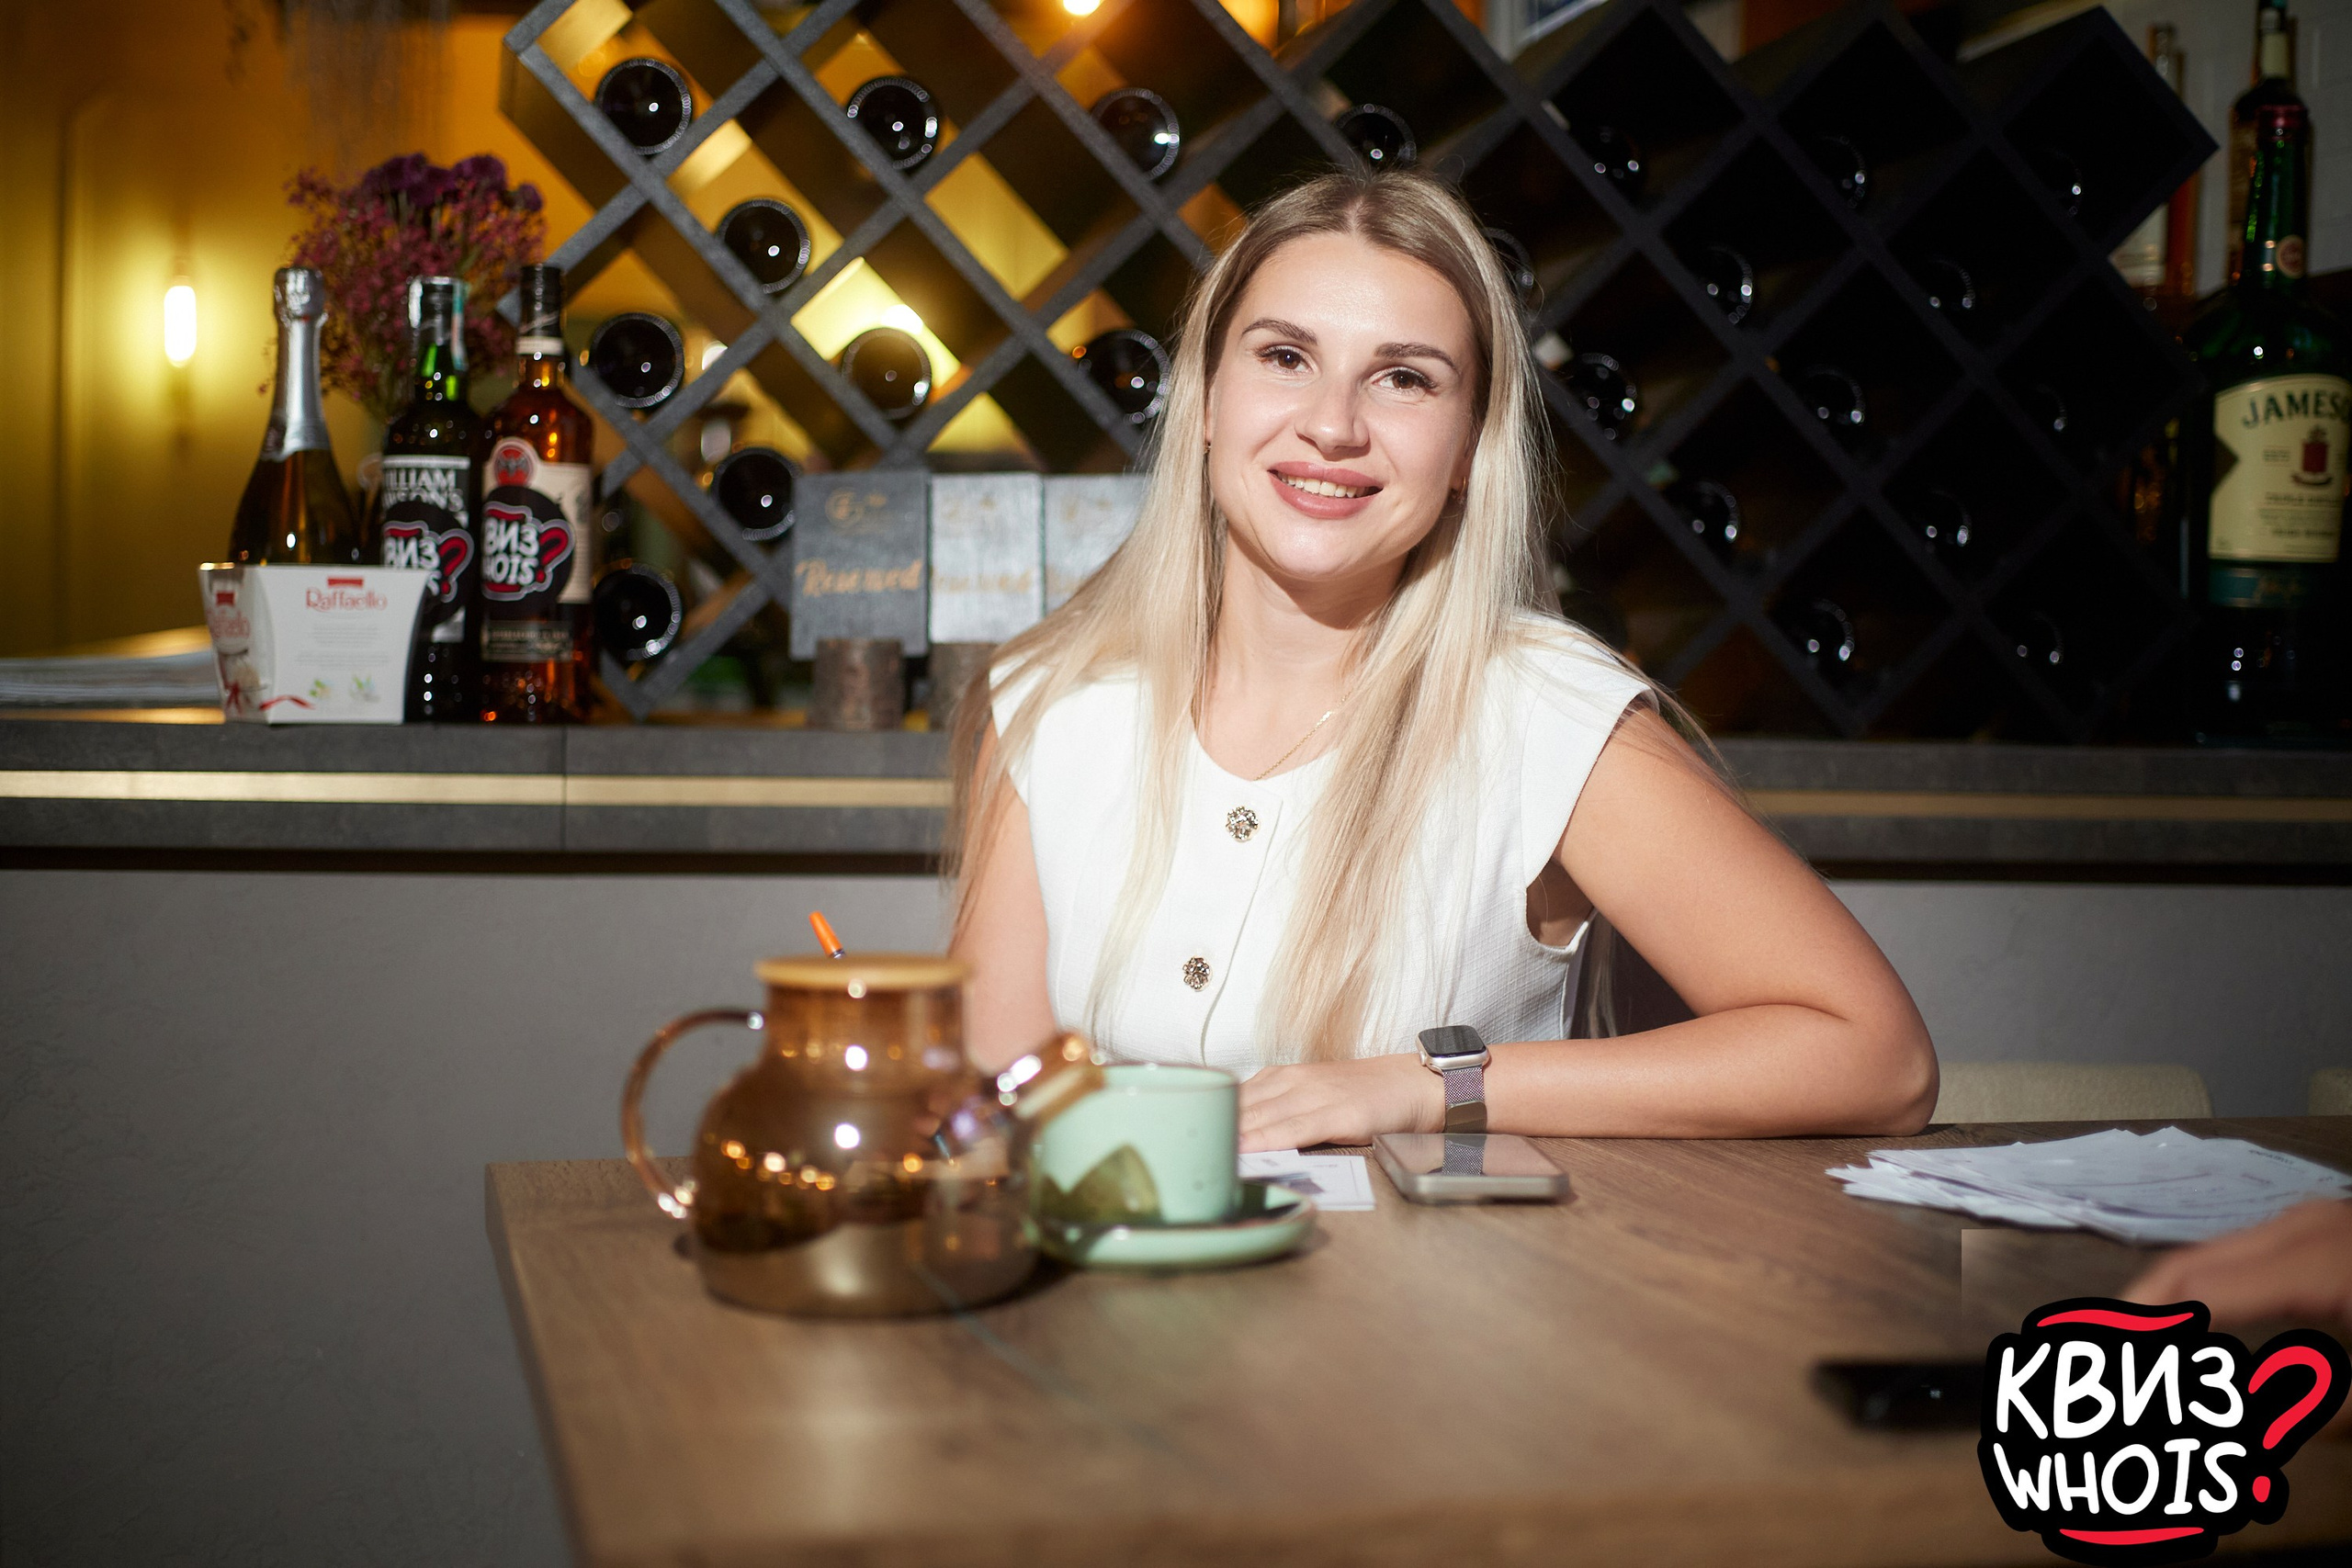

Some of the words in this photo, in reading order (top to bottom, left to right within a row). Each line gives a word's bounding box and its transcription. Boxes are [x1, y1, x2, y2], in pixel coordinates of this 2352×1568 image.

[384, 533, 440, 570] ВИЗ
[483, 516, 540, 558] ВИЗ
[305, 586, 388, 613] Raffaello
